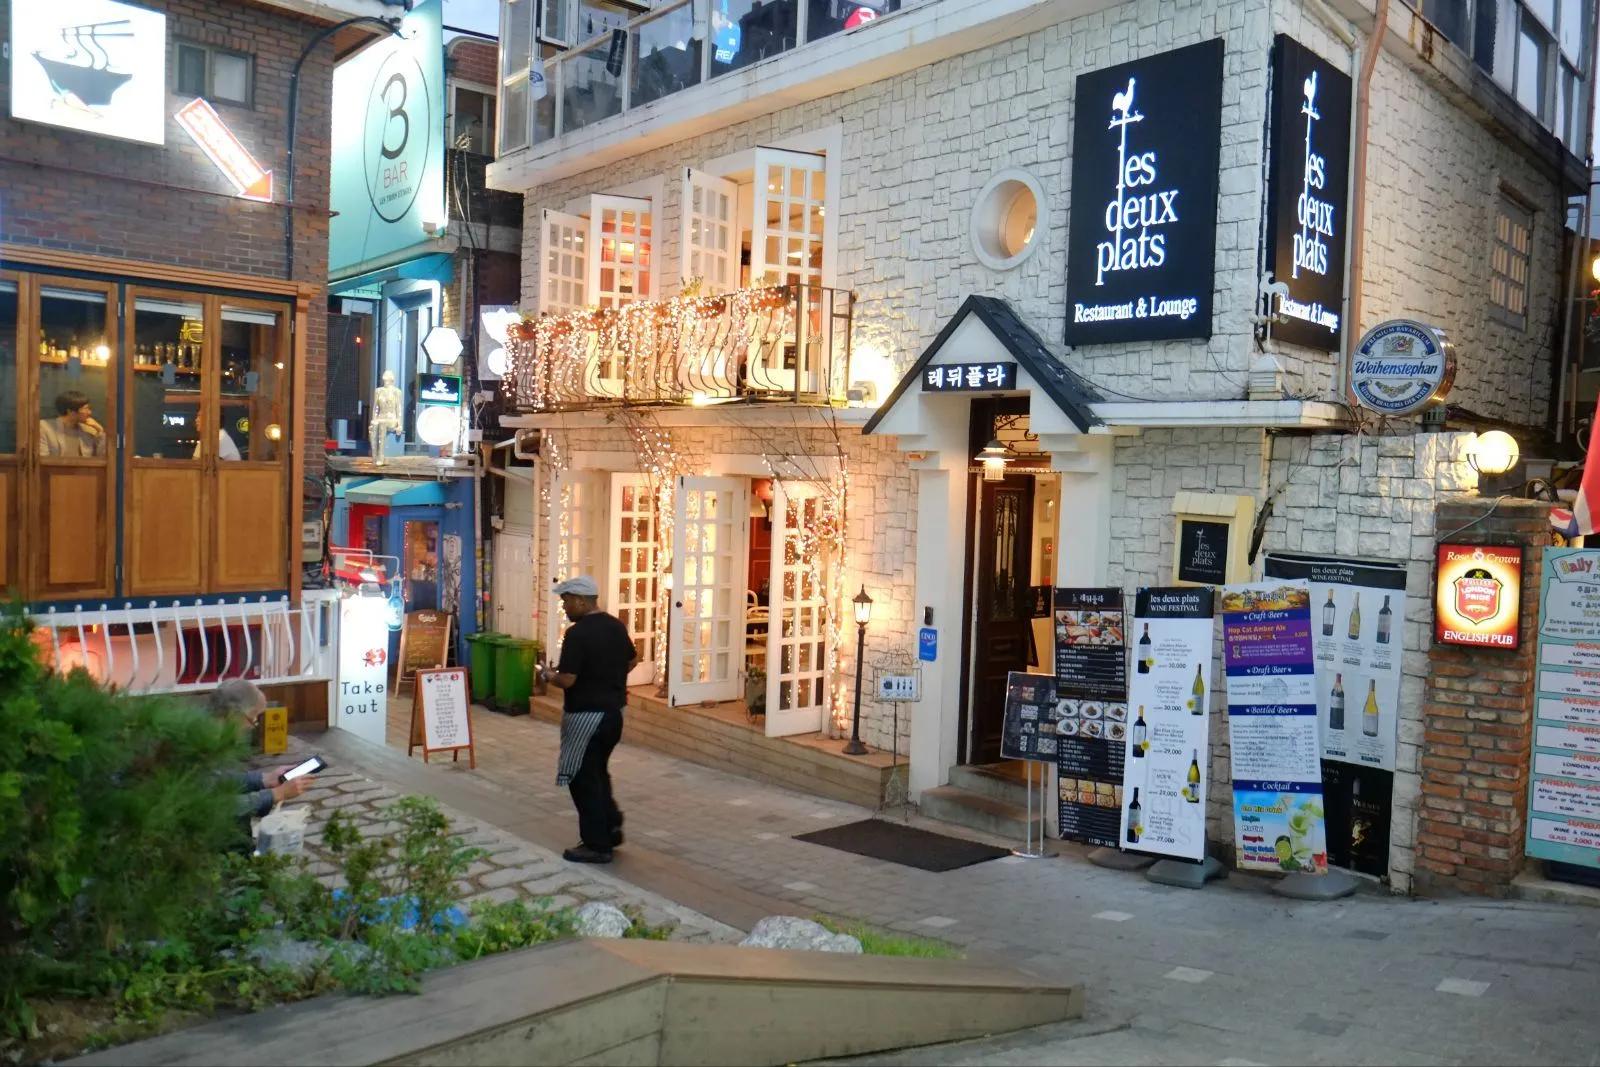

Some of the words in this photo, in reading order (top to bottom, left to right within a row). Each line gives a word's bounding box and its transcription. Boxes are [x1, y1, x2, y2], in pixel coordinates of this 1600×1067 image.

[380, 72, 410, 160] 3
[1115, 145, 1157, 189] les
[383, 161, 408, 189] BAR
[1105, 189, 1179, 232] deux
[1297, 192, 1335, 238] deux
[1095, 231, 1165, 286] plats
[1292, 232, 1328, 279] plats
[1074, 300, 1133, 323] Restaurant
[1135, 297, 1147, 318] &
[1149, 296, 1197, 320] Lounge
[1317, 304, 1339, 334] Lounge
[1366, 327, 1396, 347] PREMIUM
[1354, 360, 1438, 377] Weihenstephan
[927, 364, 1006, 389] 레뒤플라
[1191, 557, 1213, 567] plats
[1194, 550, 1216, 560] deux
[1322, 566, 1337, 575] deux
[1461, 586, 1496, 597] LONDON
[1465, 593, 1491, 601] PRIDE
[1150, 594, 1161, 603] les
[1162, 594, 1181, 603] deux
[1181, 594, 1200, 605] plats
[1150, 604, 1168, 612] WINE
[1168, 604, 1199, 612] FESTIVAL
[1267, 611, 1284, 620] Beer
[1253, 625, 1274, 633] Amber
[1443, 630, 1489, 643] ENGLISH
[1491, 634, 1514, 645] PUB
[1271, 666, 1288, 674] Beer
[341, 680, 384, 695] Take
[345, 699, 378, 715] out
[1277, 706, 1294, 714] Beer
[1261, 780, 1292, 791] Cocktail
